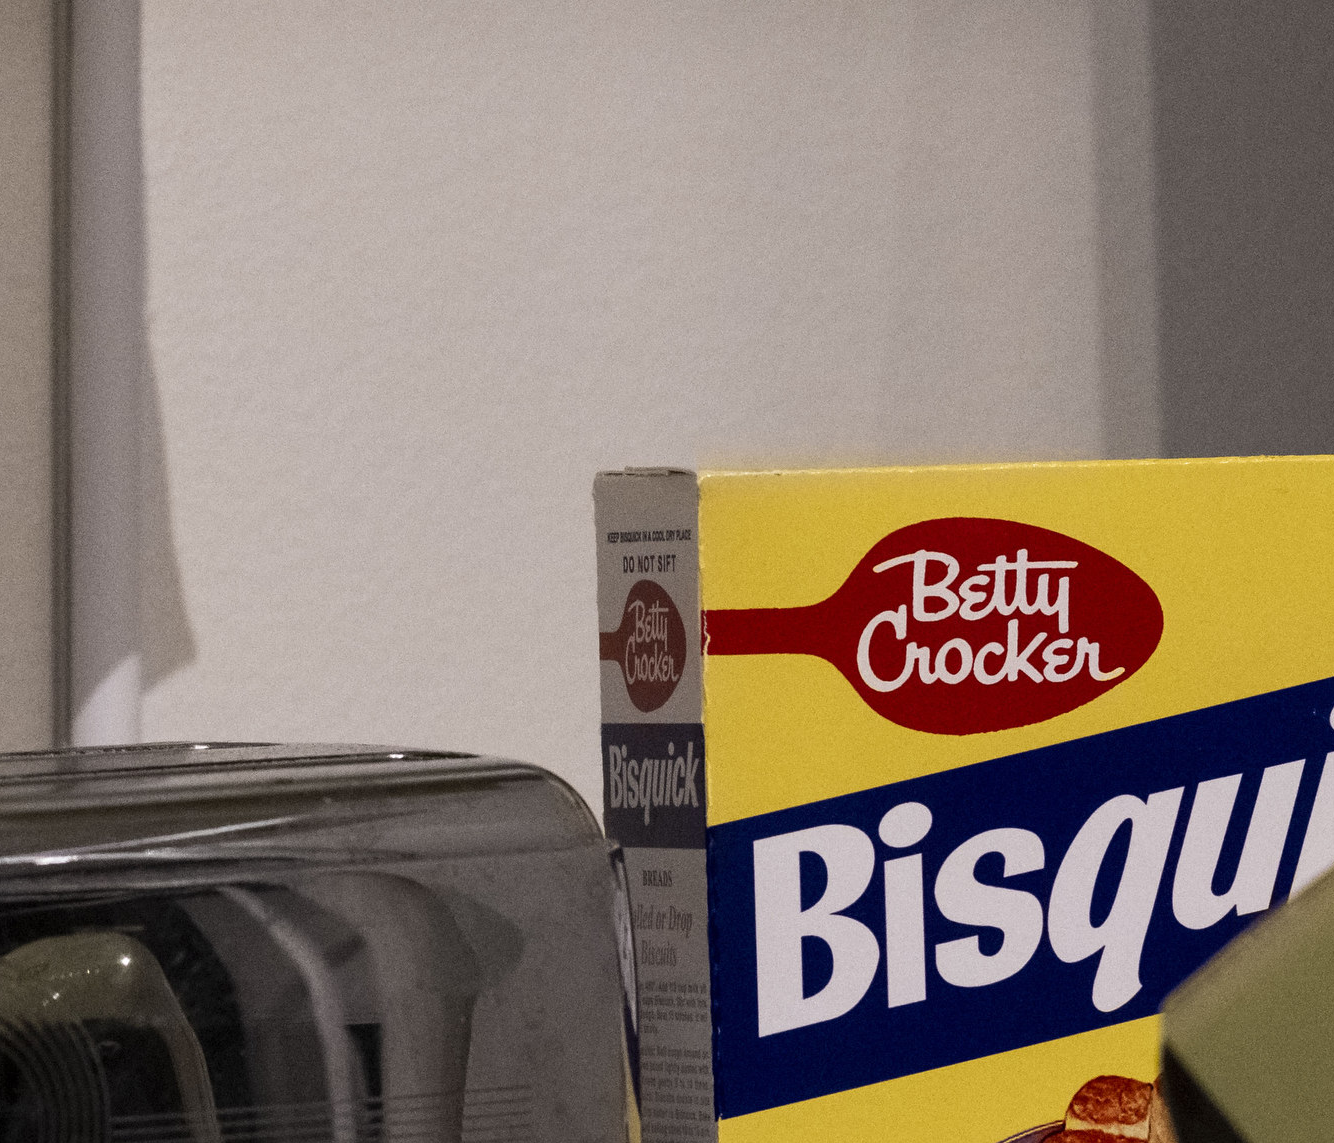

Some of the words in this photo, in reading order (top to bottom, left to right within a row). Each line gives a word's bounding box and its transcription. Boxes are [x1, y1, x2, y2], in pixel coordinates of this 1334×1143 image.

[607, 532, 620, 543] KEEP
[620, 532, 642, 543] BISQUICK
[652, 530, 665, 542] COOL
[675, 529, 692, 541] PLACE
[623, 555, 635, 573] DO
[638, 555, 655, 573] NOT
[657, 554, 677, 573] SIFT
[872, 548, 1078, 633] Betty
[627, 599, 670, 652] Betty
[856, 604, 1126, 693] Crocker
[625, 631, 680, 685] Crocker
[609, 740, 700, 827] Bisquick
[642, 869, 673, 887] BREADS
[656, 910, 666, 930] or
[668, 905, 693, 939] Drop
